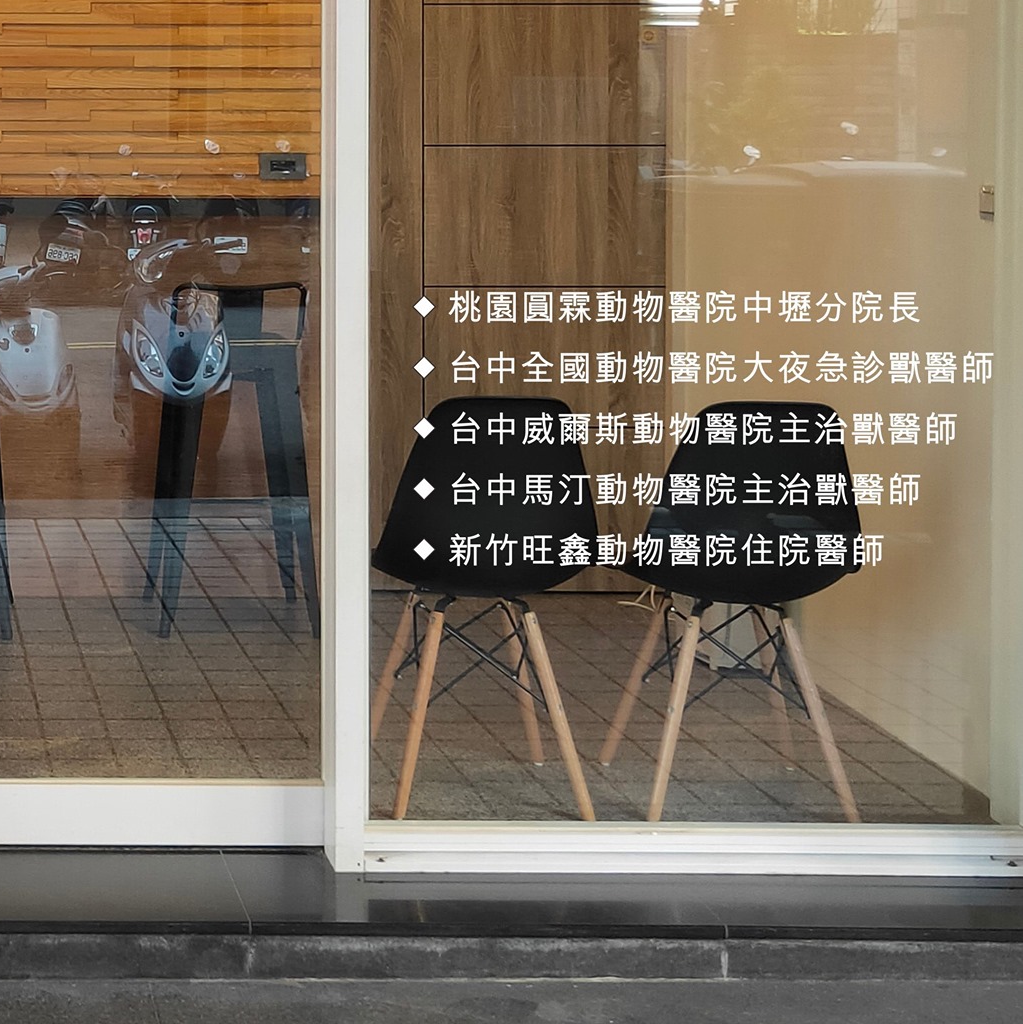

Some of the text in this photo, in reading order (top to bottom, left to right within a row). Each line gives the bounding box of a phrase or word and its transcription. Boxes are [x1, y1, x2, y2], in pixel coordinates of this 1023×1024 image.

[451, 350, 994, 385] 台中全國動物醫院大夜急診獸醫師
[451, 411, 958, 446] 台中威爾斯動物醫院主治獸醫師
[451, 472, 921, 506] 台中馬汀動物醫院主治獸醫師
[449, 532, 885, 567] 新竹旺鑫動物醫院住院醫師
